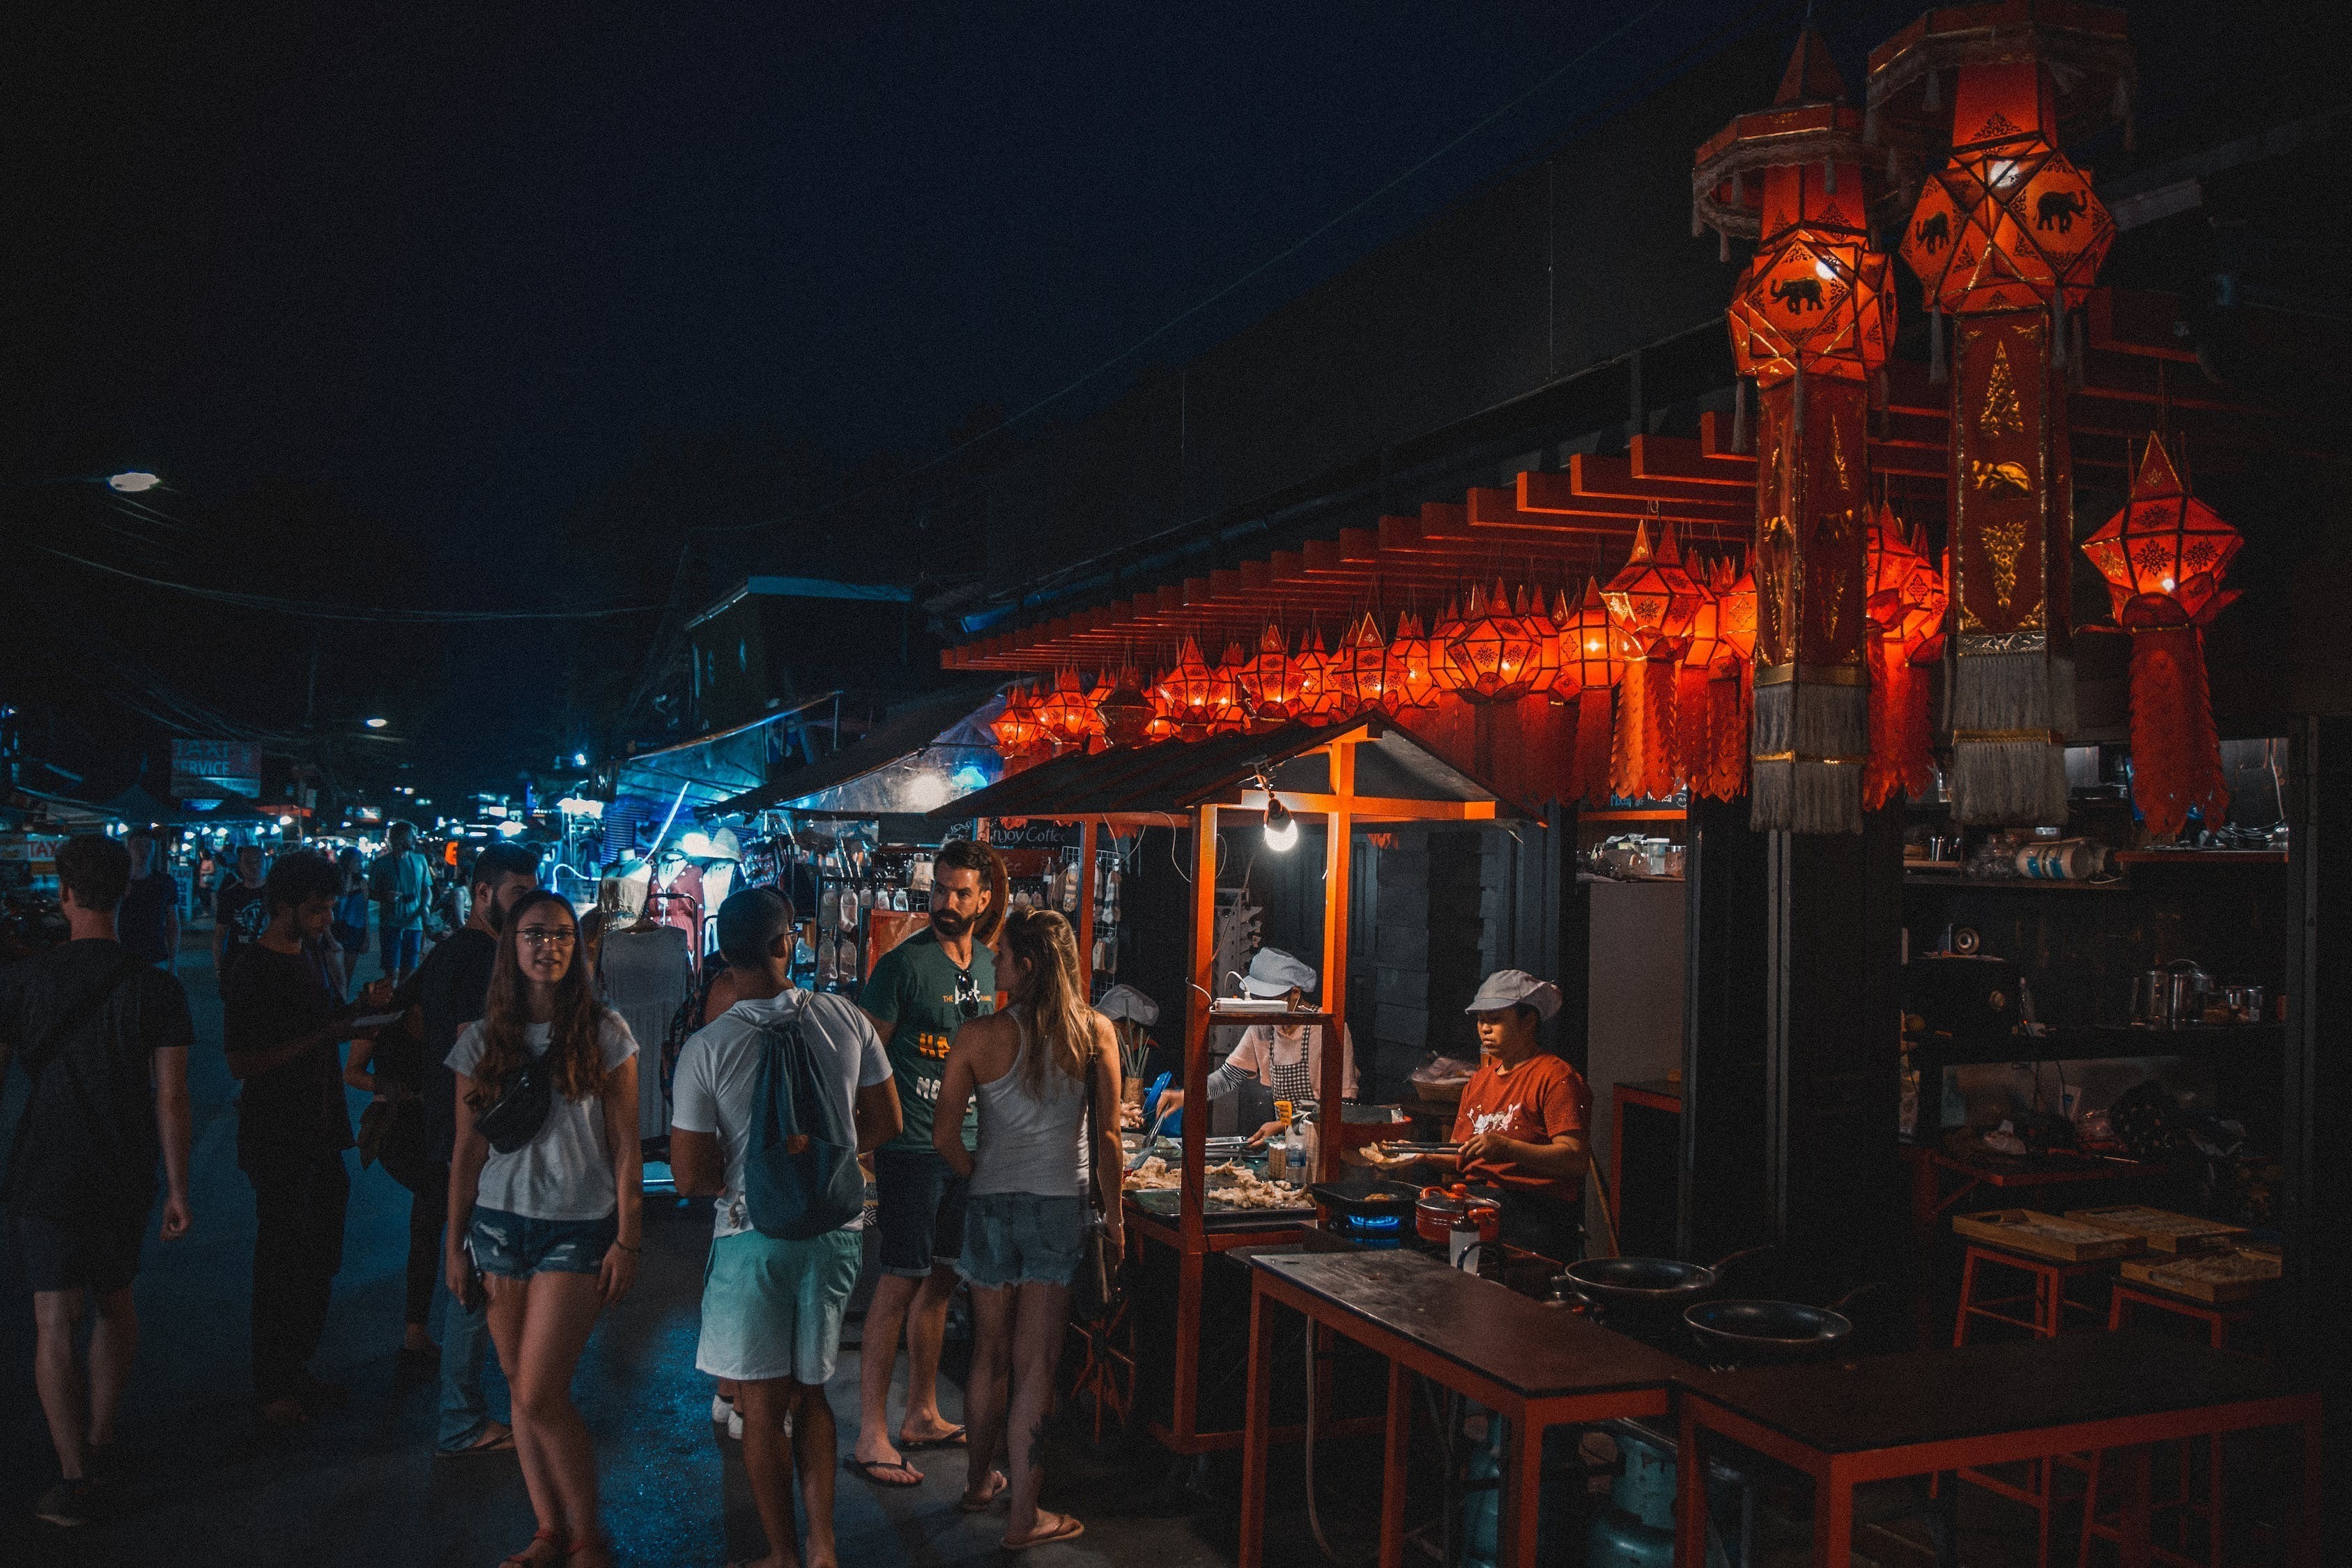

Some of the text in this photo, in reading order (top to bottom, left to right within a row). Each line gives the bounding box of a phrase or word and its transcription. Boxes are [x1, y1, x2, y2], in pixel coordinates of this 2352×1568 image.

[171, 738, 230, 758] TAXI
[990, 825, 1024, 845] njoy
[942, 994, 954, 1003] THE
